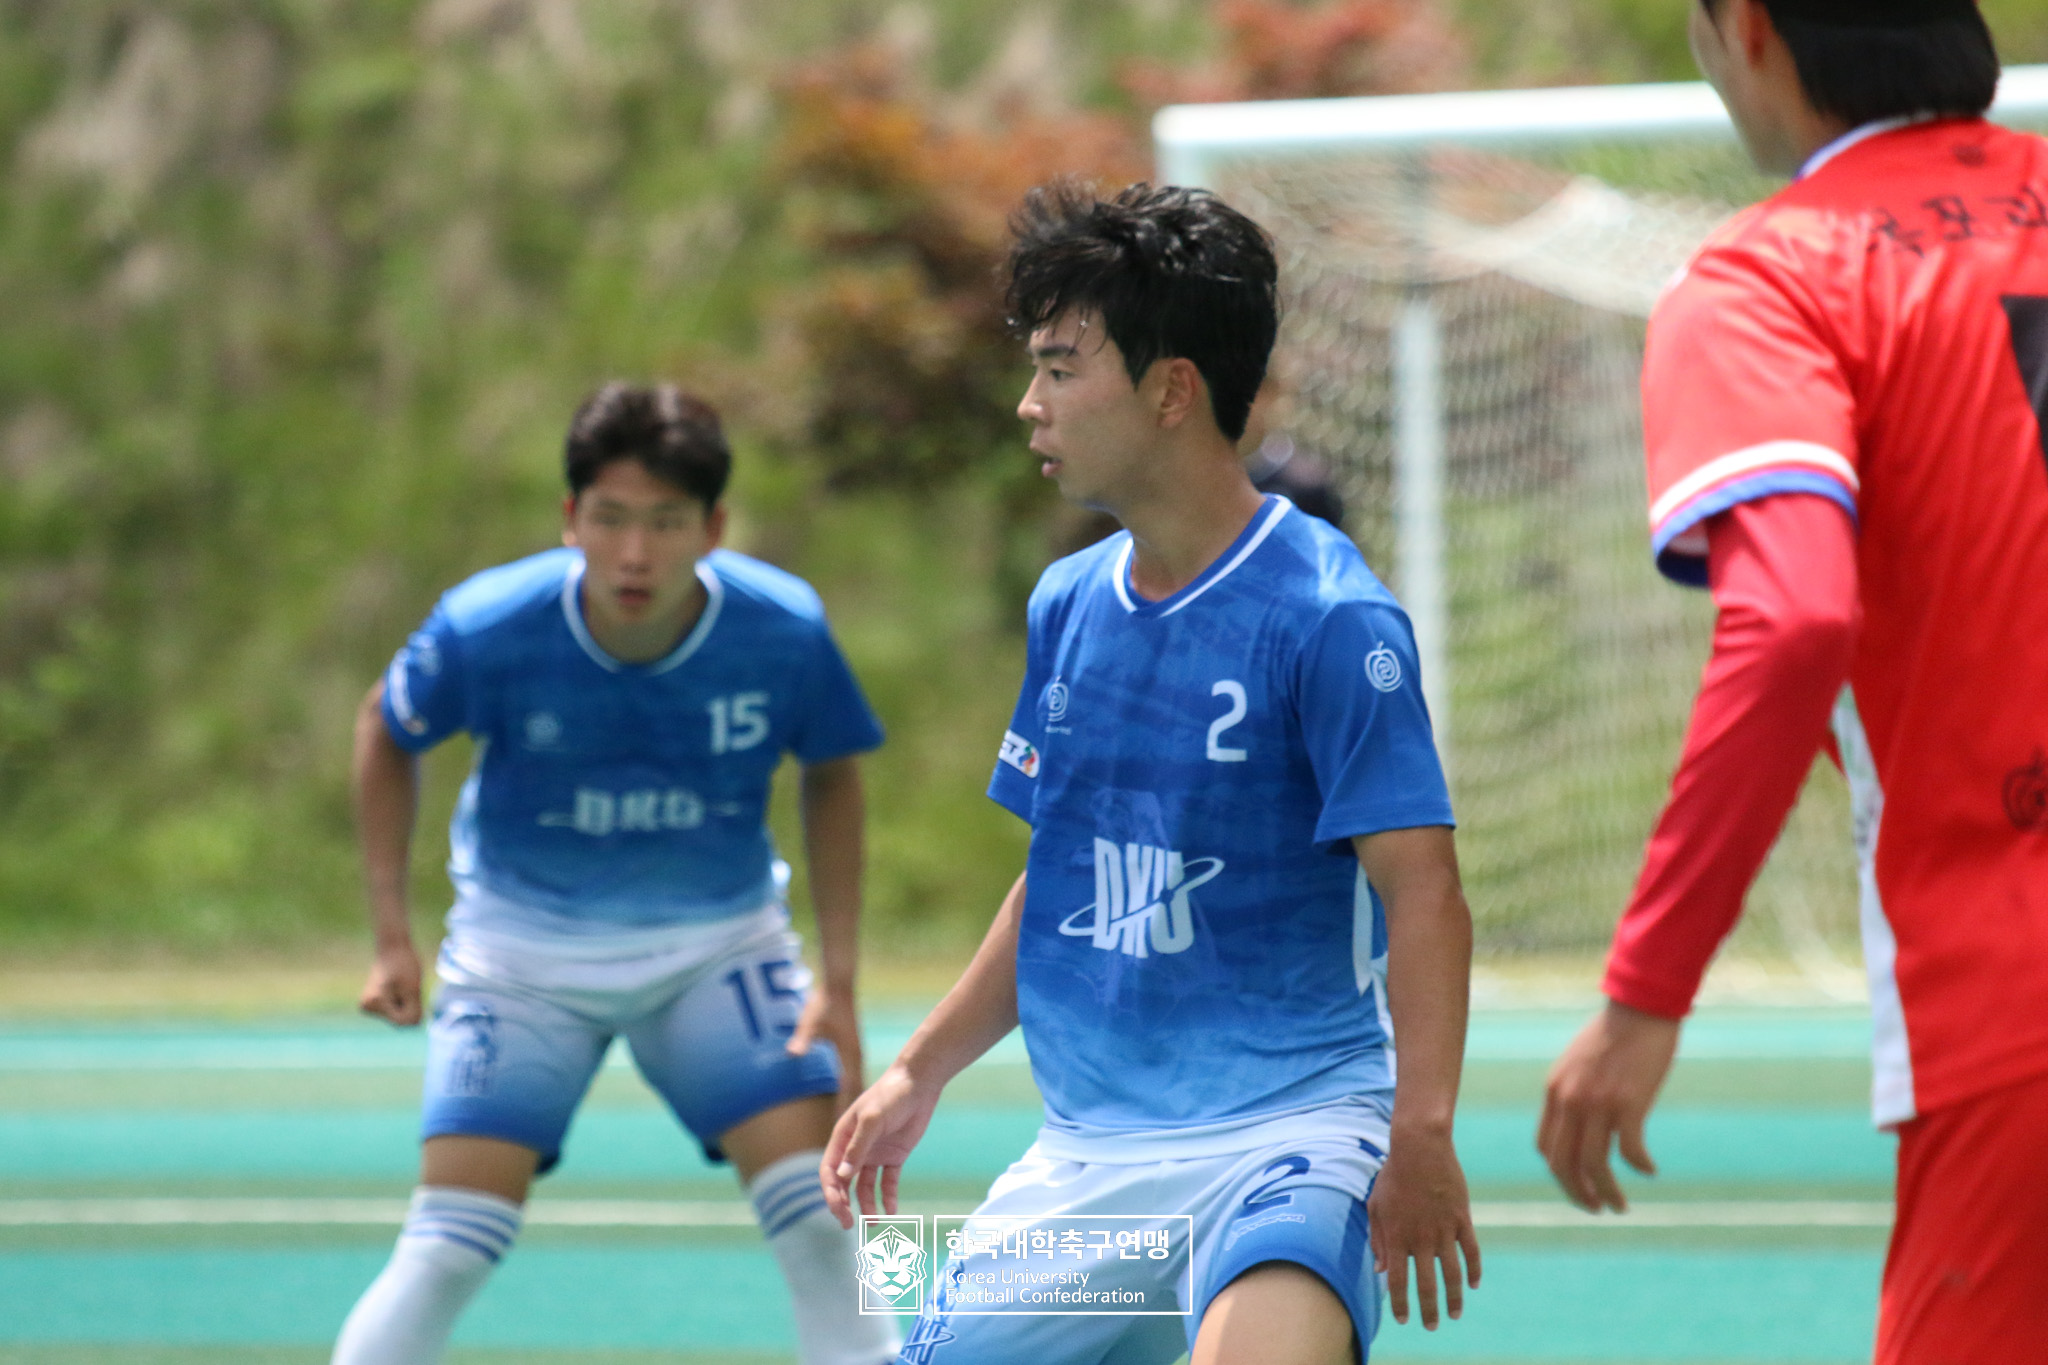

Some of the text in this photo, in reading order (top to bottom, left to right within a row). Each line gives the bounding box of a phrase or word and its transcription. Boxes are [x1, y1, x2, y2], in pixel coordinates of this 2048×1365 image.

[707, 692, 770, 754] 15
[1206, 679, 1248, 762] 2
[1091, 836, 1196, 959] DKU
[1236, 1155, 1311, 1220] 2
